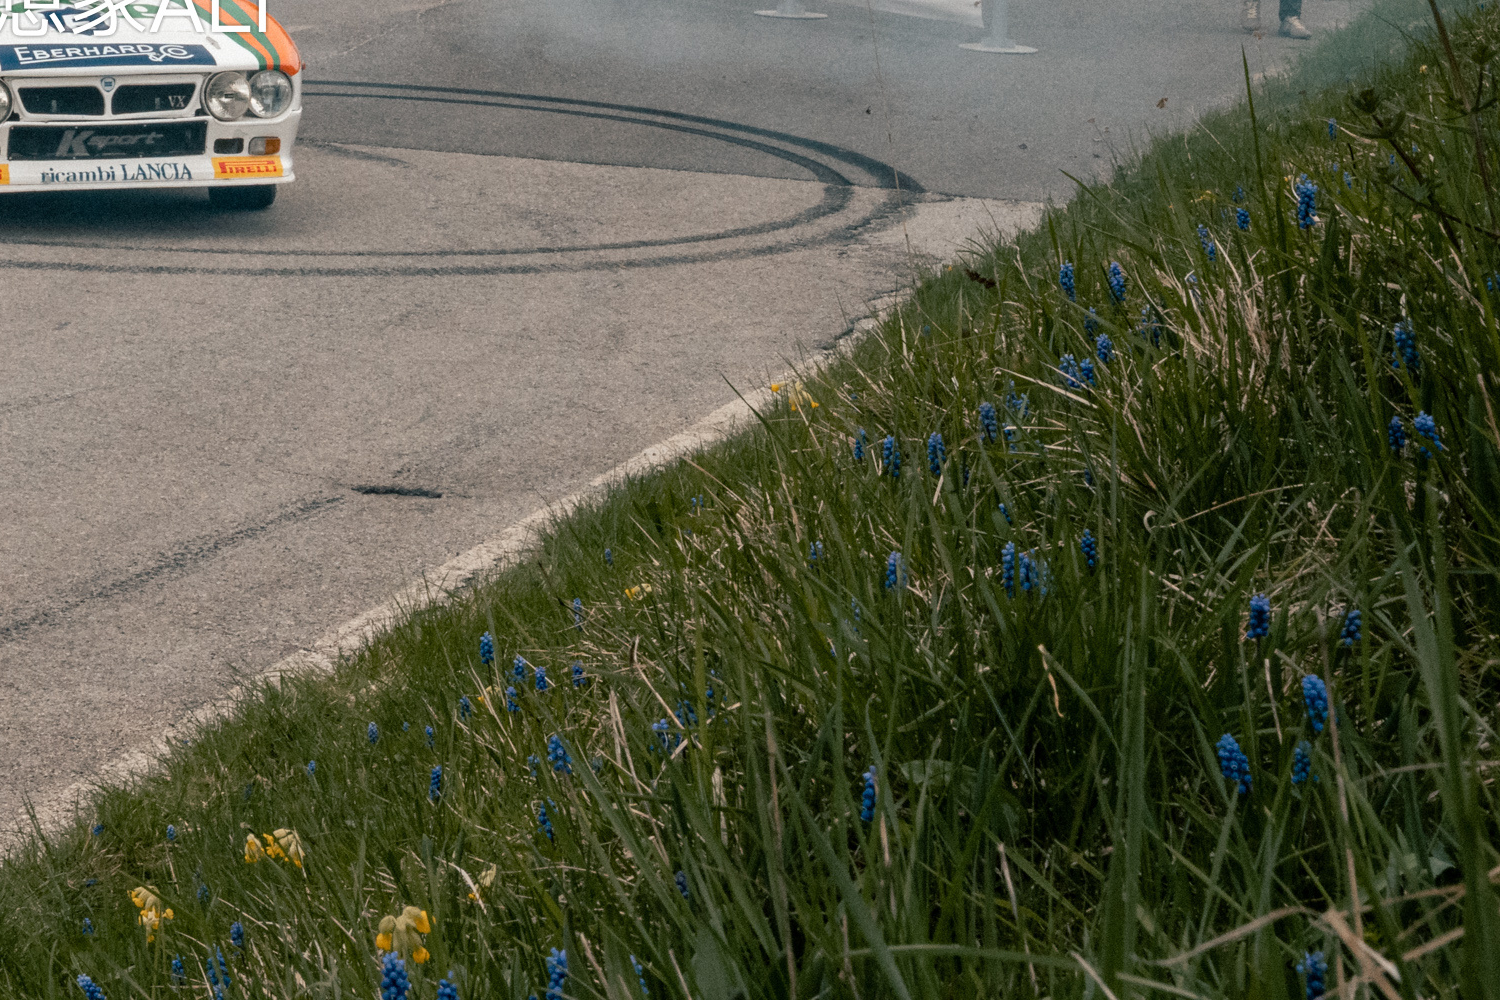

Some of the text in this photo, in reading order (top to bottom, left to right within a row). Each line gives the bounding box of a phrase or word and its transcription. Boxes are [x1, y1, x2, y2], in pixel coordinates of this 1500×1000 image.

[168, 95, 186, 108] VX
[40, 162, 193, 184] ricambi LANCIA
[218, 160, 277, 174] PIRELLI
